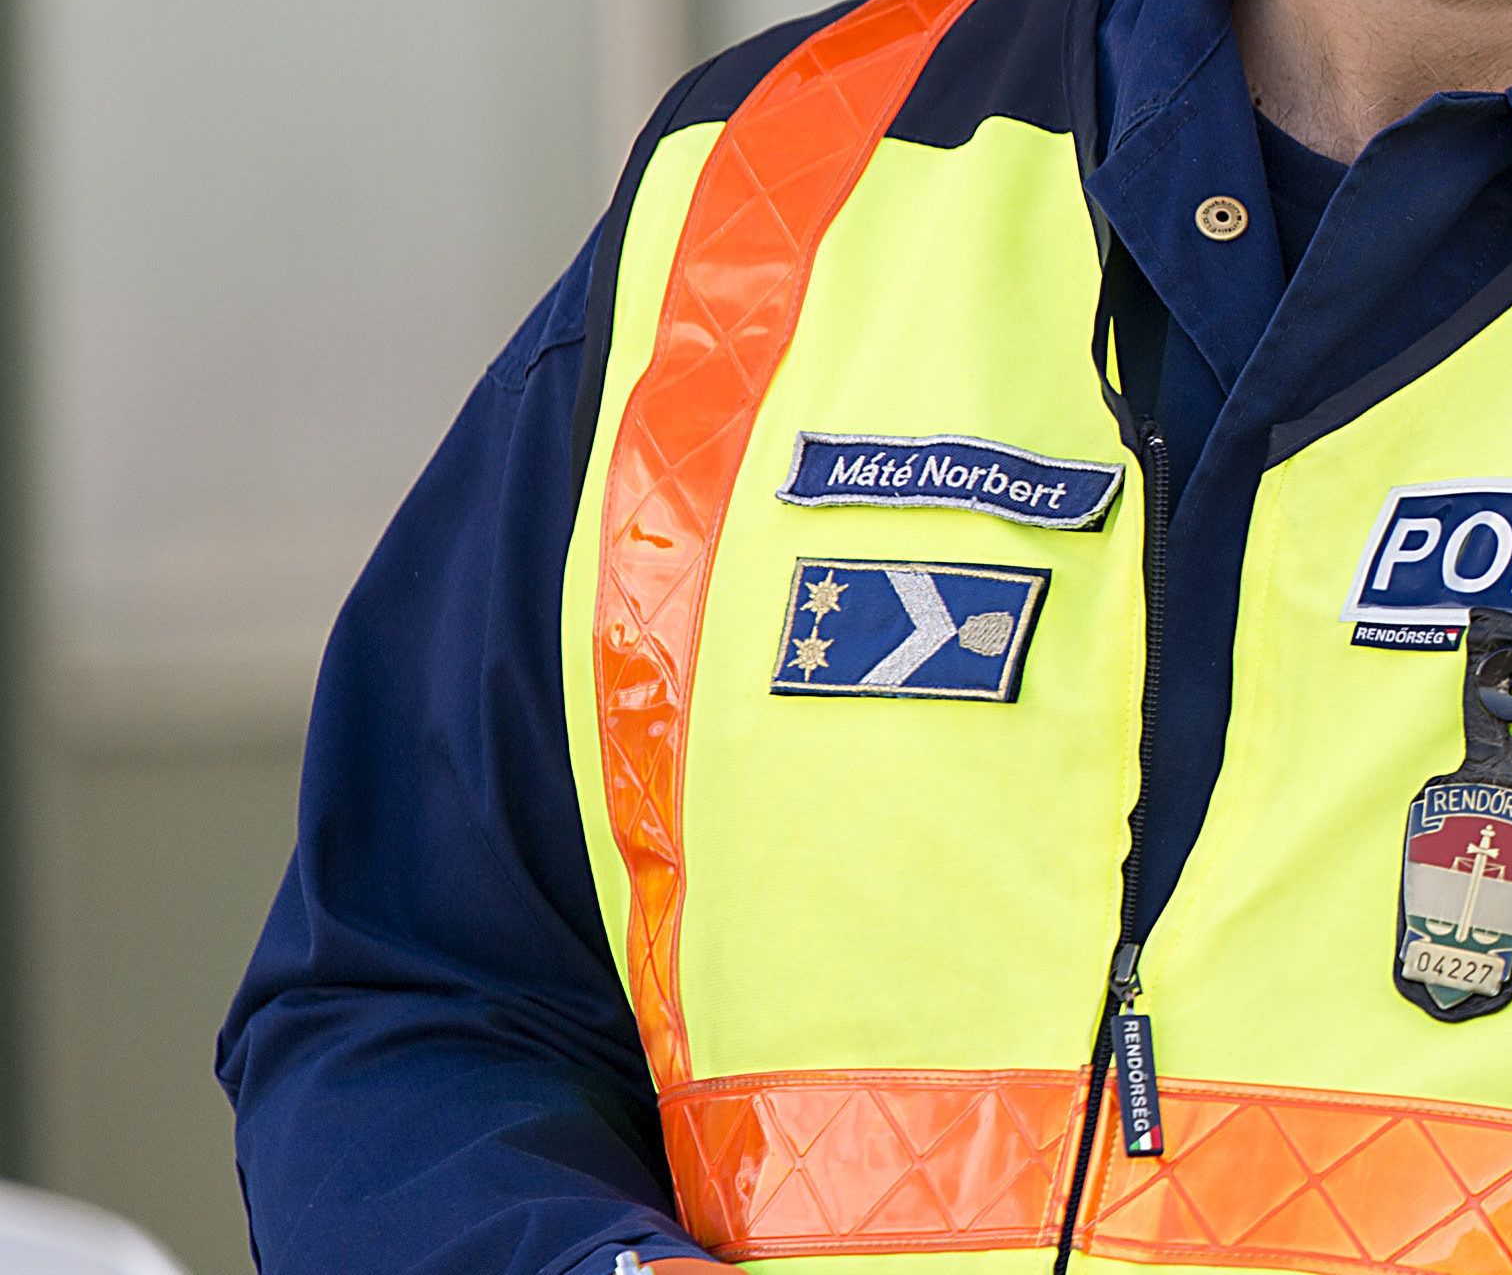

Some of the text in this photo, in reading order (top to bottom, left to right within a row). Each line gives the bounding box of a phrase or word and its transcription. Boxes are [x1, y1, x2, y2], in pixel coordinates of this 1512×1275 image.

[826, 451, 1067, 510] Máté Norbert
[1355, 626, 1445, 644] RENDŐRSÉG
[1416, 951, 1494, 985] 04227
[1123, 1020, 1152, 1132] RENDŐRSÉG
